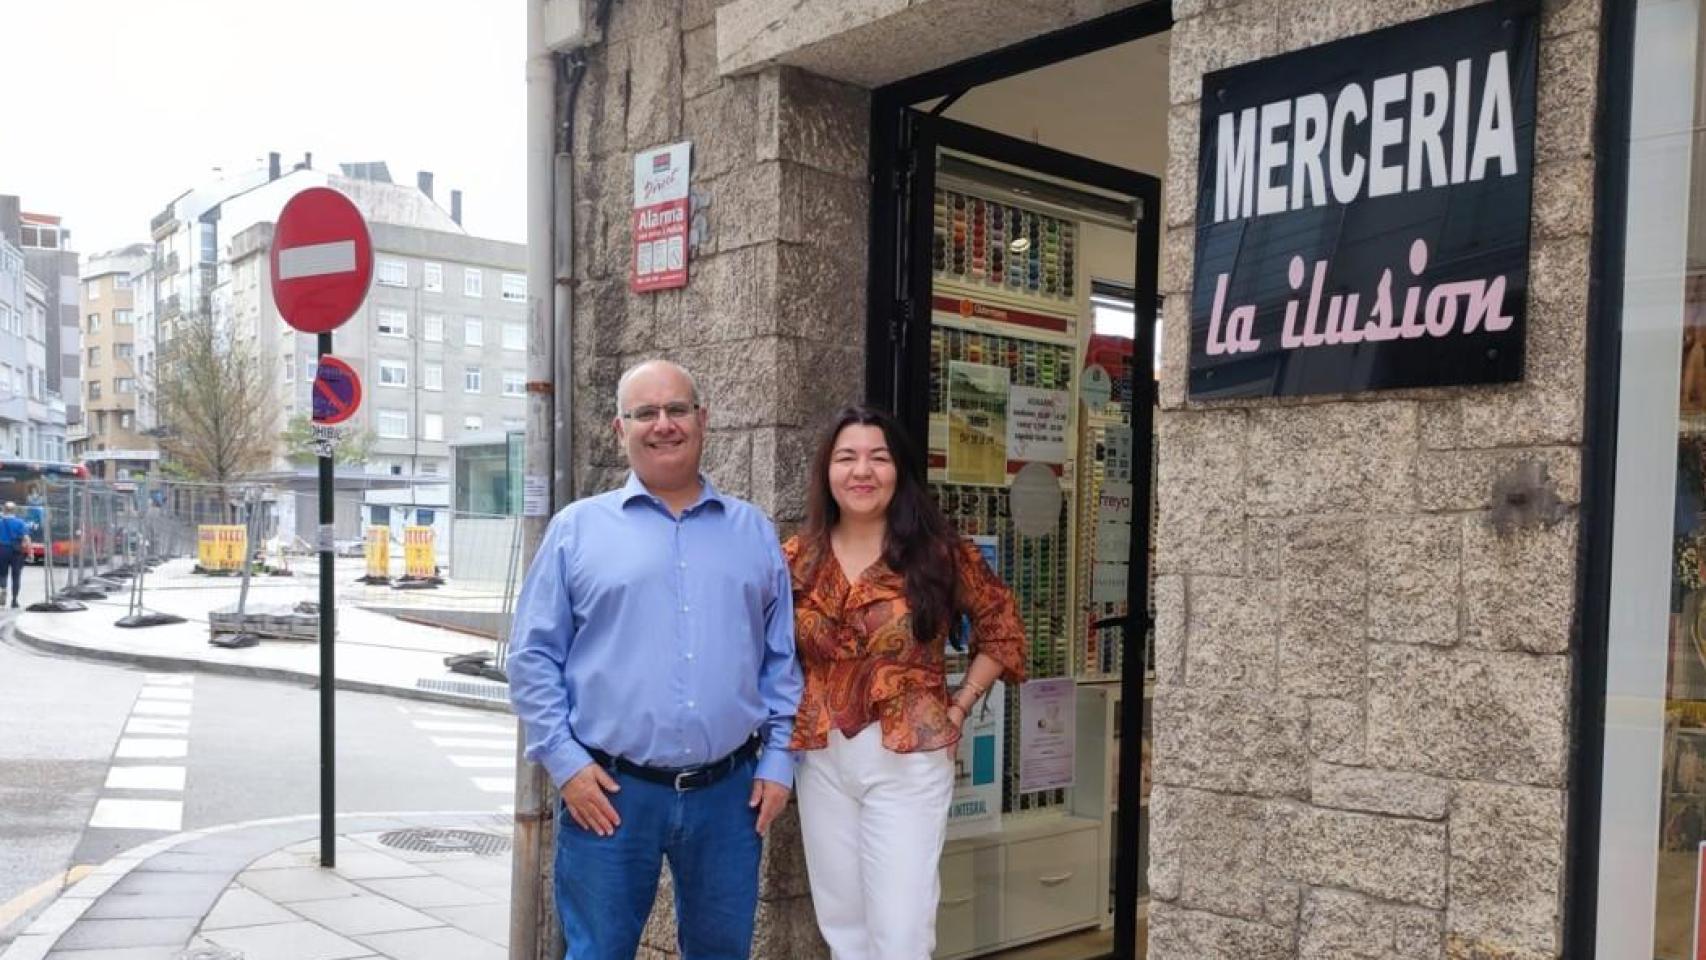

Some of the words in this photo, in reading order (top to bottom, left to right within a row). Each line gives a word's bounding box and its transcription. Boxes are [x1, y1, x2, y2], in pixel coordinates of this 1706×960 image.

[1214, 50, 1518, 223] MERCERIA
[638, 207, 684, 229] Alarma
[1206, 273, 1261, 355] la
[1281, 238, 1513, 349] ilusion
[1098, 489, 1130, 512] Freya
